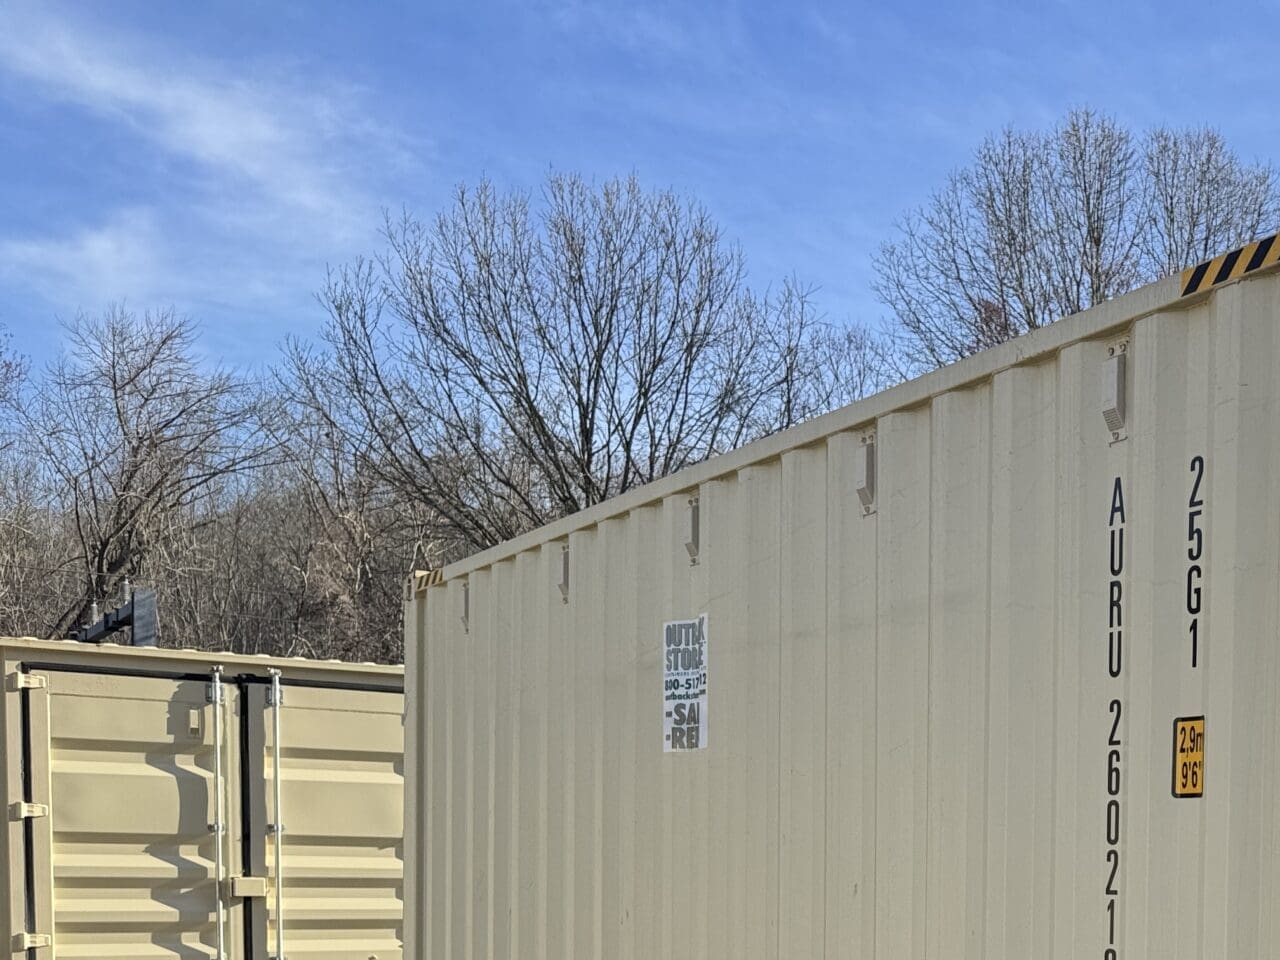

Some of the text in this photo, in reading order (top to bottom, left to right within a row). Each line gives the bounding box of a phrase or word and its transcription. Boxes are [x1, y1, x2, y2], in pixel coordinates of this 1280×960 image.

[1109, 477, 1125, 678] AURU
[1187, 455, 1204, 668] 25G1
[671, 727, 699, 749] RE
[674, 702, 699, 726] SA
